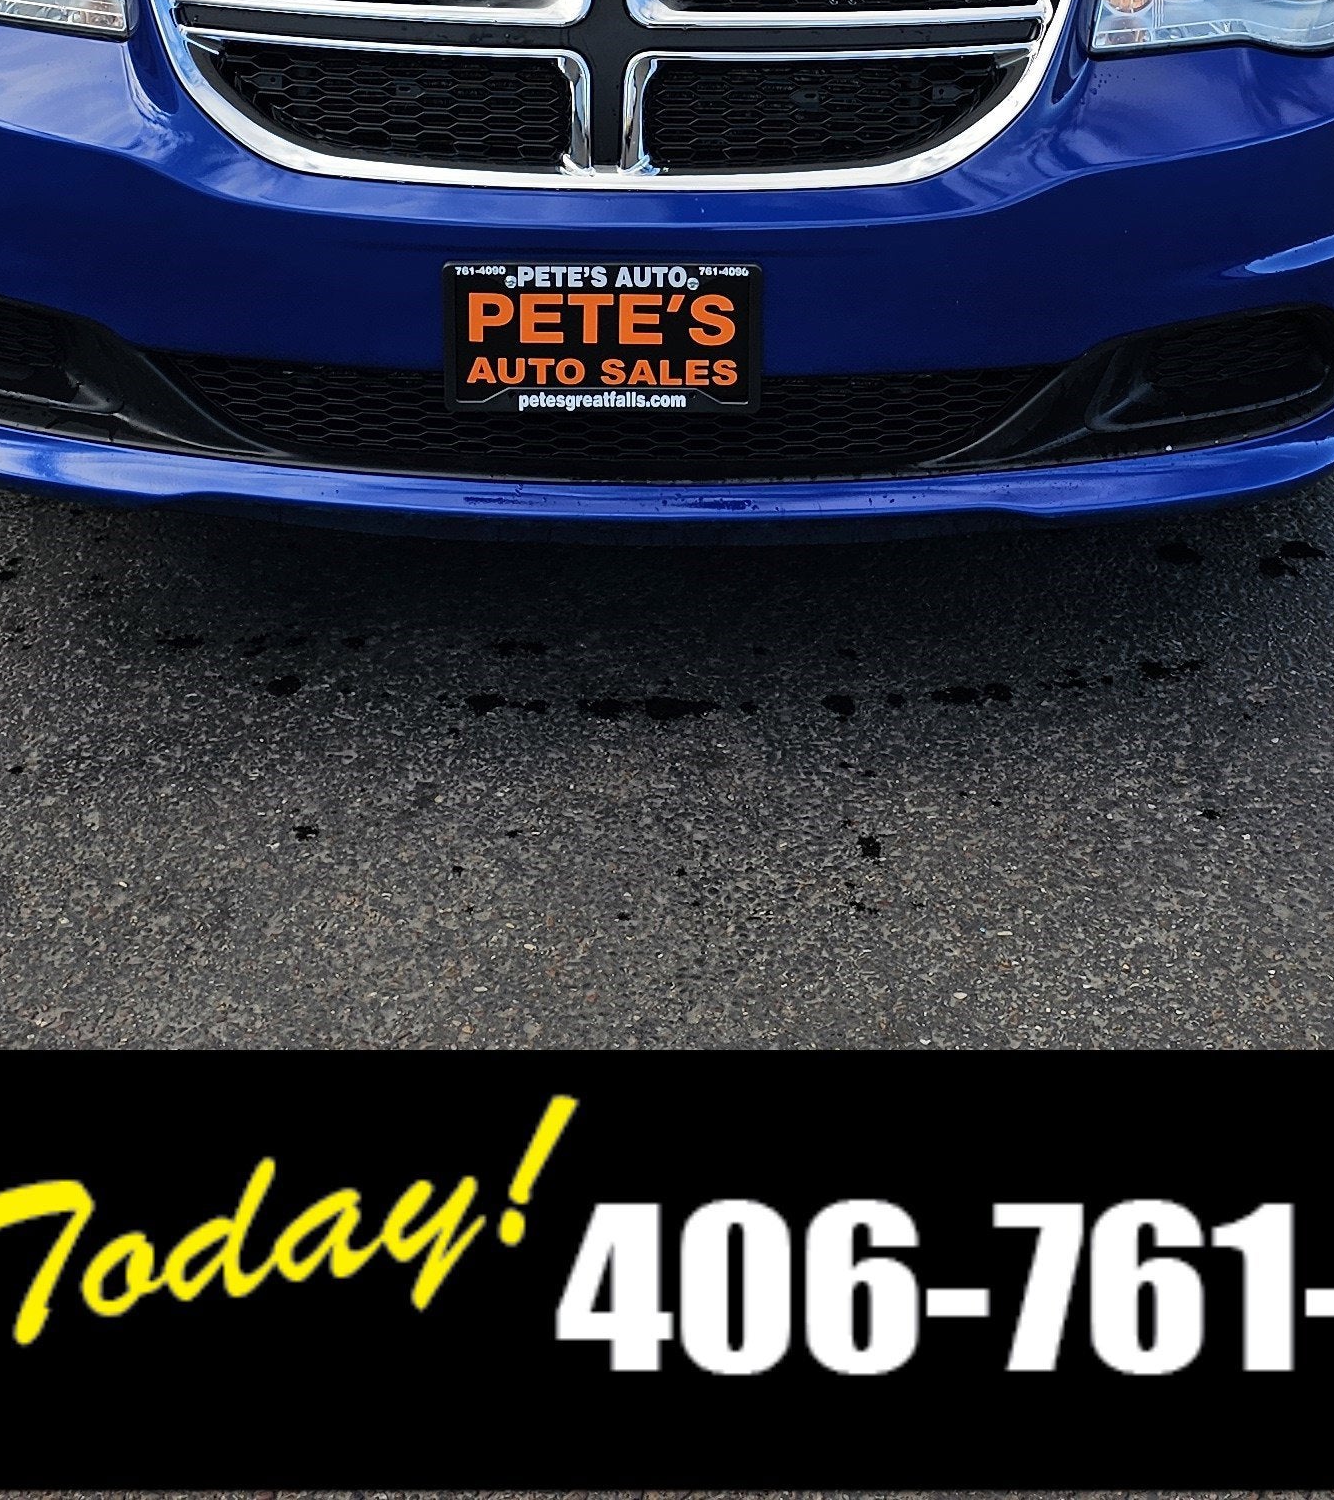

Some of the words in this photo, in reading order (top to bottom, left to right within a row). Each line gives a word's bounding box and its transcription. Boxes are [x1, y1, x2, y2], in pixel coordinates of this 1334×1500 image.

[455, 266, 506, 276] 761-4090
[517, 266, 608, 287] PETE'S
[615, 266, 687, 287] AUTO
[468, 292, 735, 346] PETE'S
[467, 357, 585, 384] AUTO
[601, 359, 738, 386] SALES
[518, 391, 686, 411] petesgreatfalls.com
